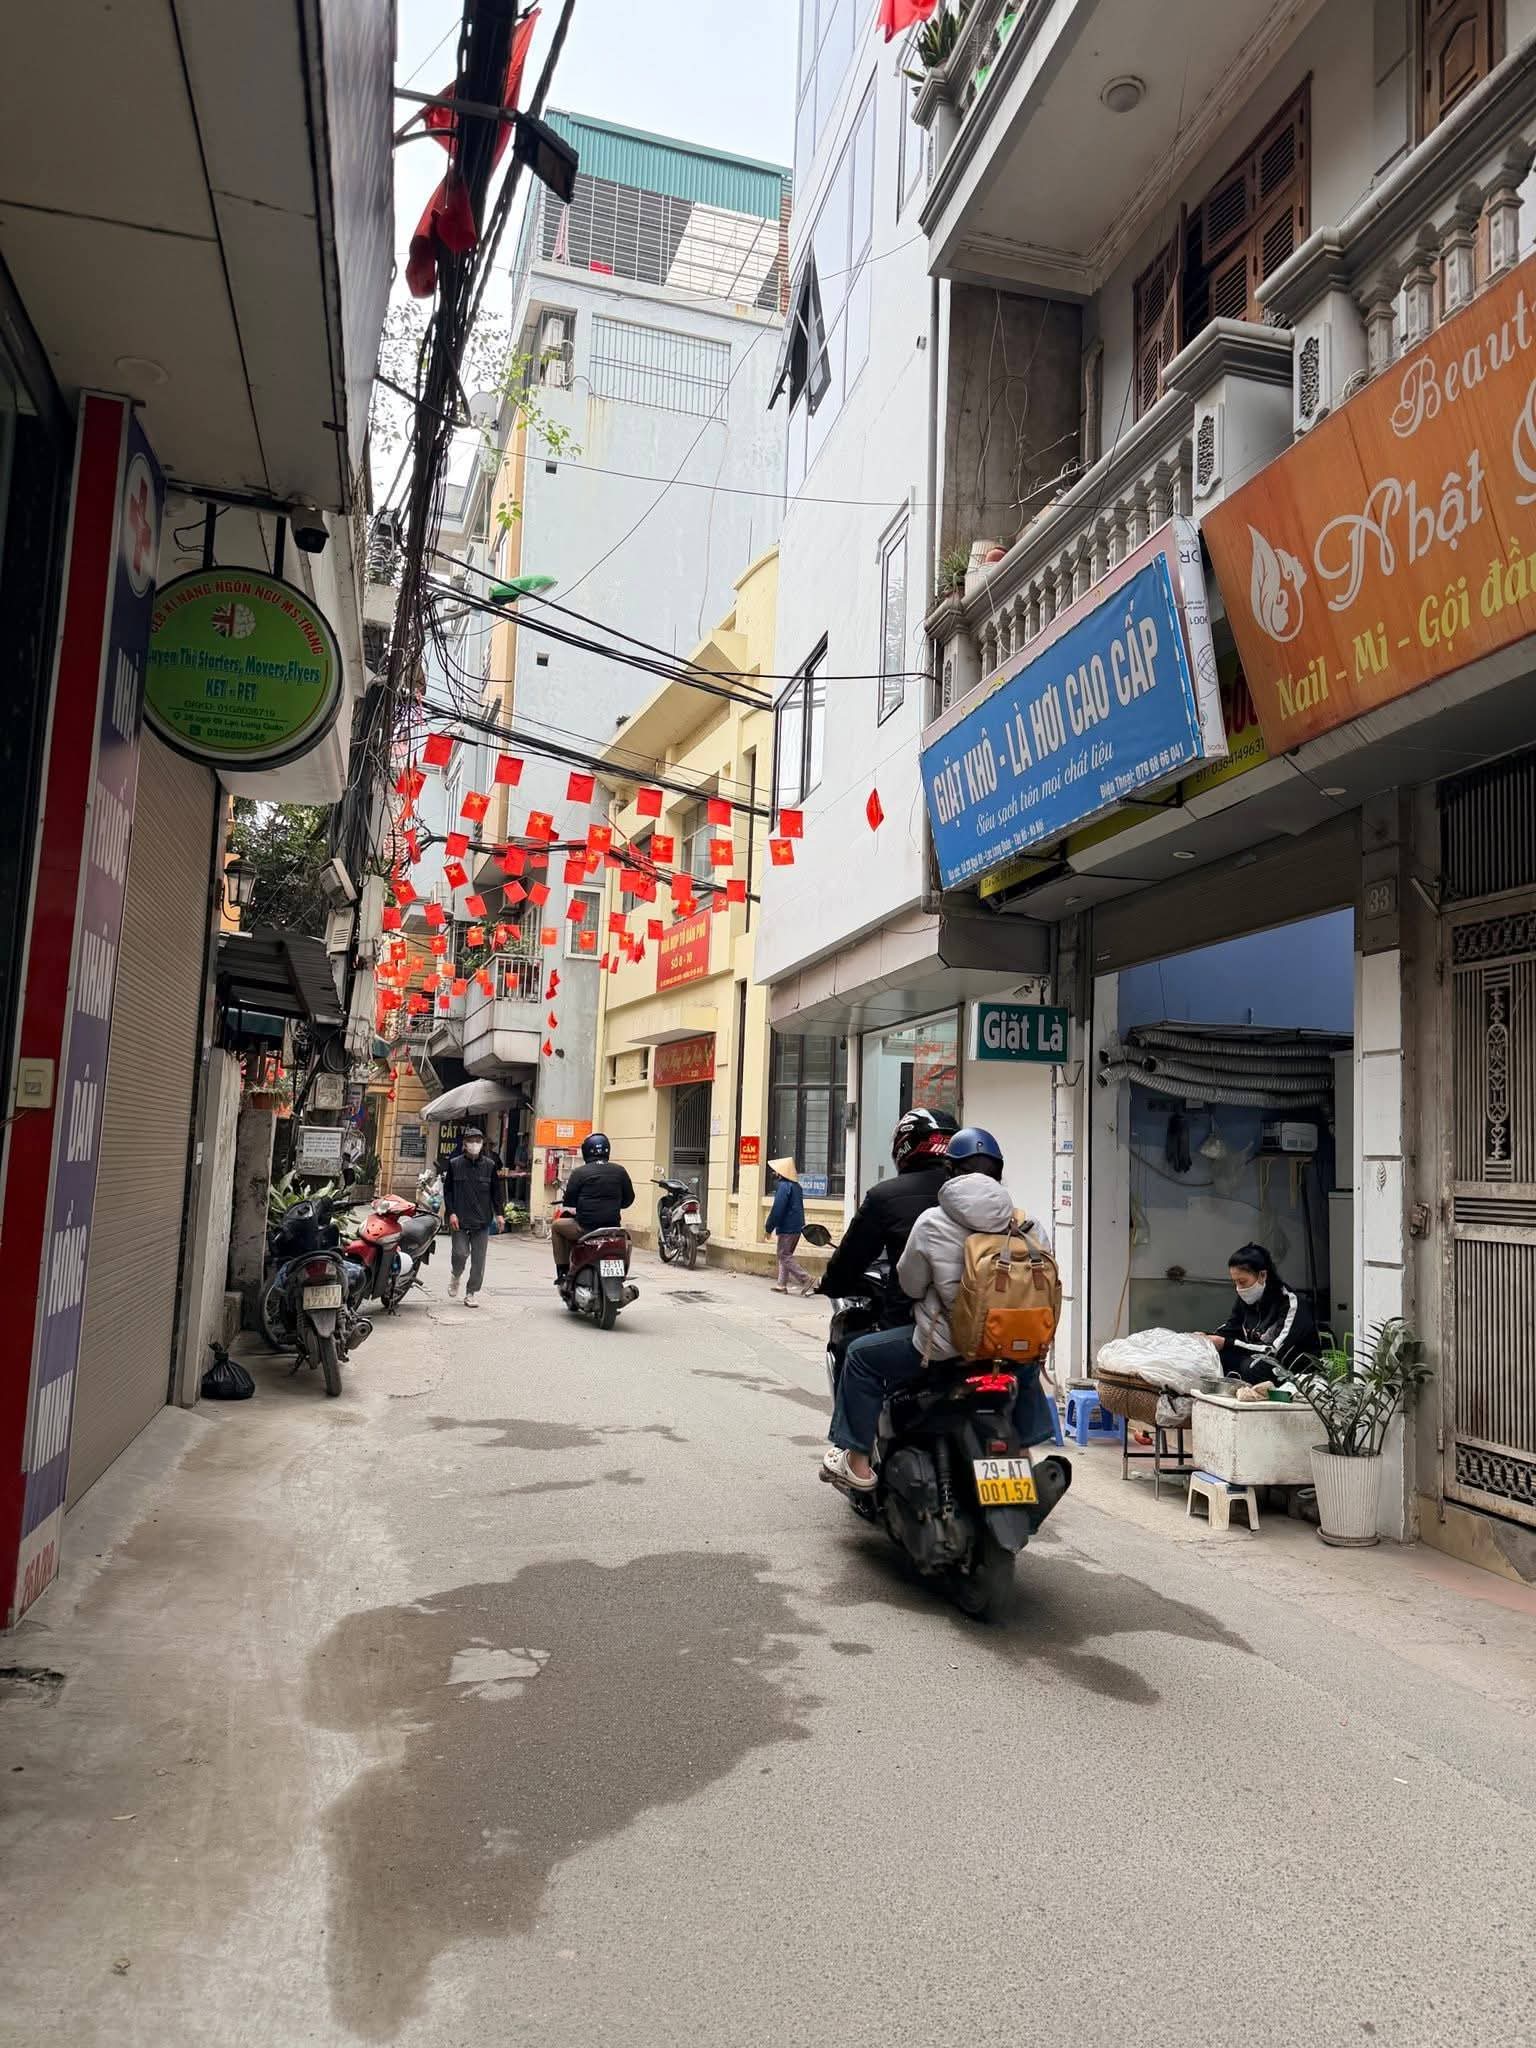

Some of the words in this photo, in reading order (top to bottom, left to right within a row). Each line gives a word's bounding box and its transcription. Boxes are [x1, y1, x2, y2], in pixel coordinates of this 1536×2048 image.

[1390, 289, 1536, 437] Beaut
[1314, 449, 1485, 612] Nhật
[206, 678, 226, 698] KET
[237, 681, 257, 700] PET
[1276, 656, 1329, 720] Nail
[1353, 622, 1389, 683] Mi
[1419, 576, 1470, 652] Gội
[933, 756, 966, 828] GIẶT
[963, 727, 998, 804] KHÔ
[1005, 702, 1033, 777] LÀ
[1029, 684, 1067, 760] HƠI
[1065, 655, 1110, 736] CAO
[1110, 600, 1159, 706] CẤP
[997, 797, 1019, 828] sạch
[1041, 771, 1062, 799] mọi
[1064, 748, 1089, 784] chất
[1091, 739, 1114, 771] liệu
[1135, 763, 1150, 781] 079
[77, 921, 116, 1021] NHÂN
[983, 1011, 1029, 1055] Giặt
[1037, 1016, 1063, 1052] Là
[67, 1064, 98, 1162] DÂN
[48, 1199, 87, 1317] HỒNG
[980, 1481, 1034, 1503] 001.52
[982, 1461, 1023, 1481] 29-AT
